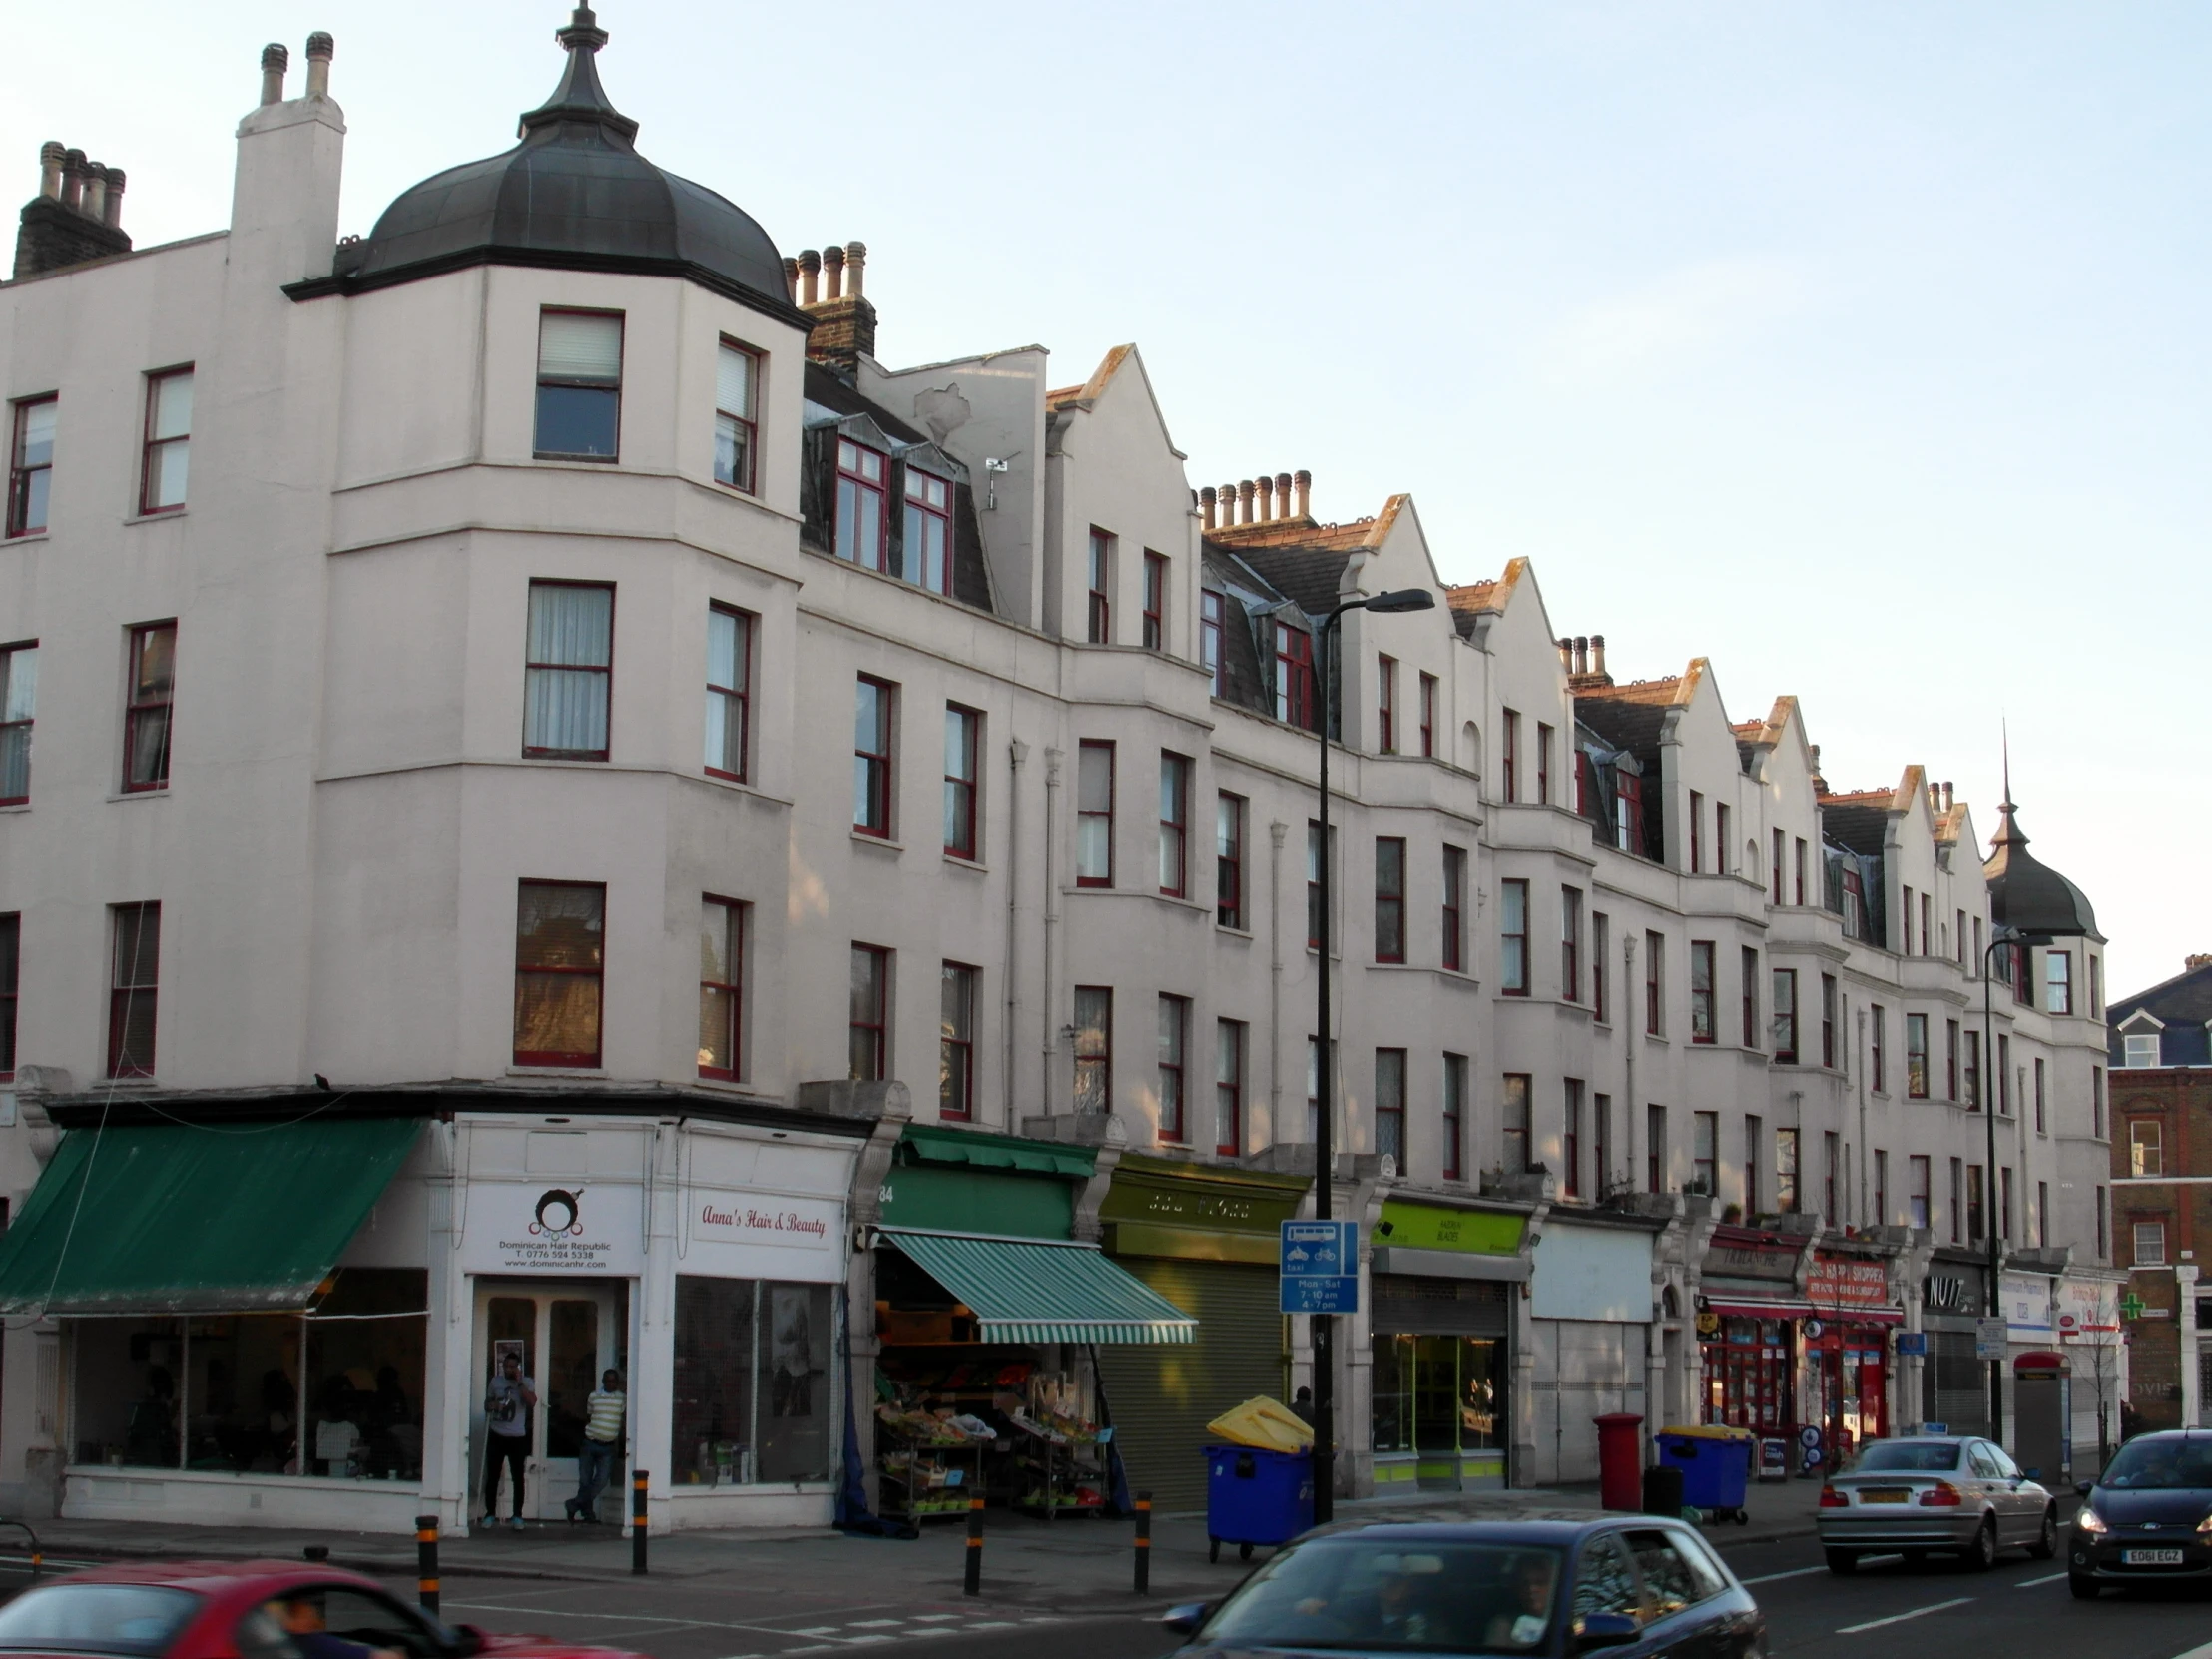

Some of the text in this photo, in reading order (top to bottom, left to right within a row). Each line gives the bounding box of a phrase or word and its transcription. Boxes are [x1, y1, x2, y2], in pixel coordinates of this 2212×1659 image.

[702, 1205, 827, 1239] Anna's Hair & Beauty
[499, 1241, 548, 1250] Dominican
[571, 1242, 611, 1251] Republic
[505, 1260, 607, 1269] www.dominicanhr.com
